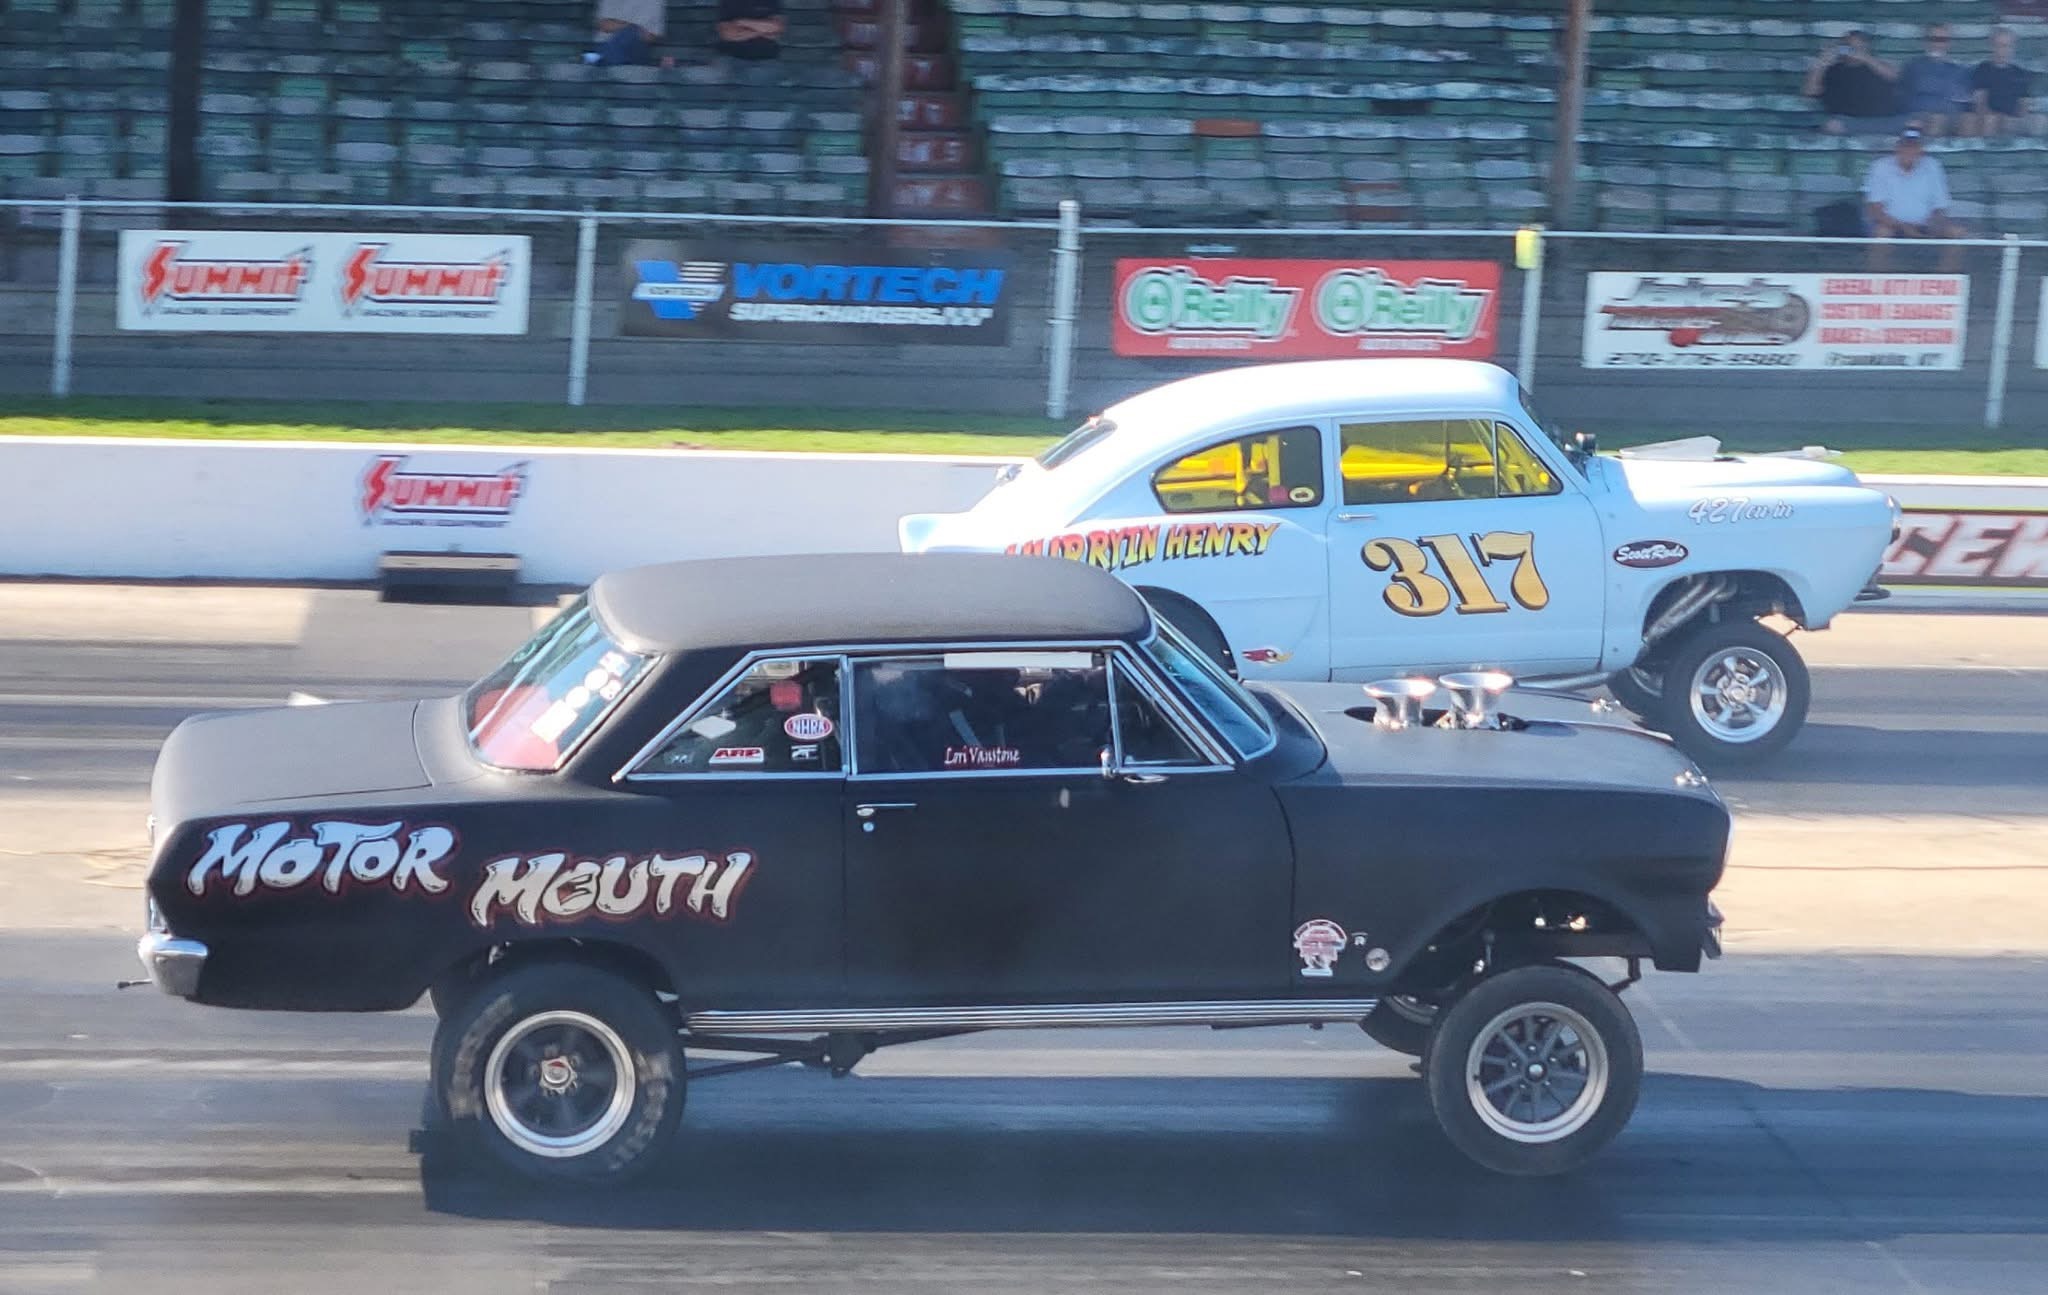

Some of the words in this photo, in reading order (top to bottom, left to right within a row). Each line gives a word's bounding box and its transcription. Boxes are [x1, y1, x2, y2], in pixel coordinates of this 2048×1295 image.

[732, 262, 1005, 305] VORTECH
[1121, 267, 1301, 340] O'Reilly
[1313, 269, 1491, 342] O'Reilly
[1688, 497, 1749, 525] 427
[1163, 522, 1281, 561] HENRY
[1360, 530, 1550, 617] 317
[790, 718, 826, 735] NHRA
[714, 749, 761, 758] ARP
[943, 745, 967, 765] Lori
[187, 821, 455, 896] MOTOR
[471, 852, 752, 927] MOUTH
